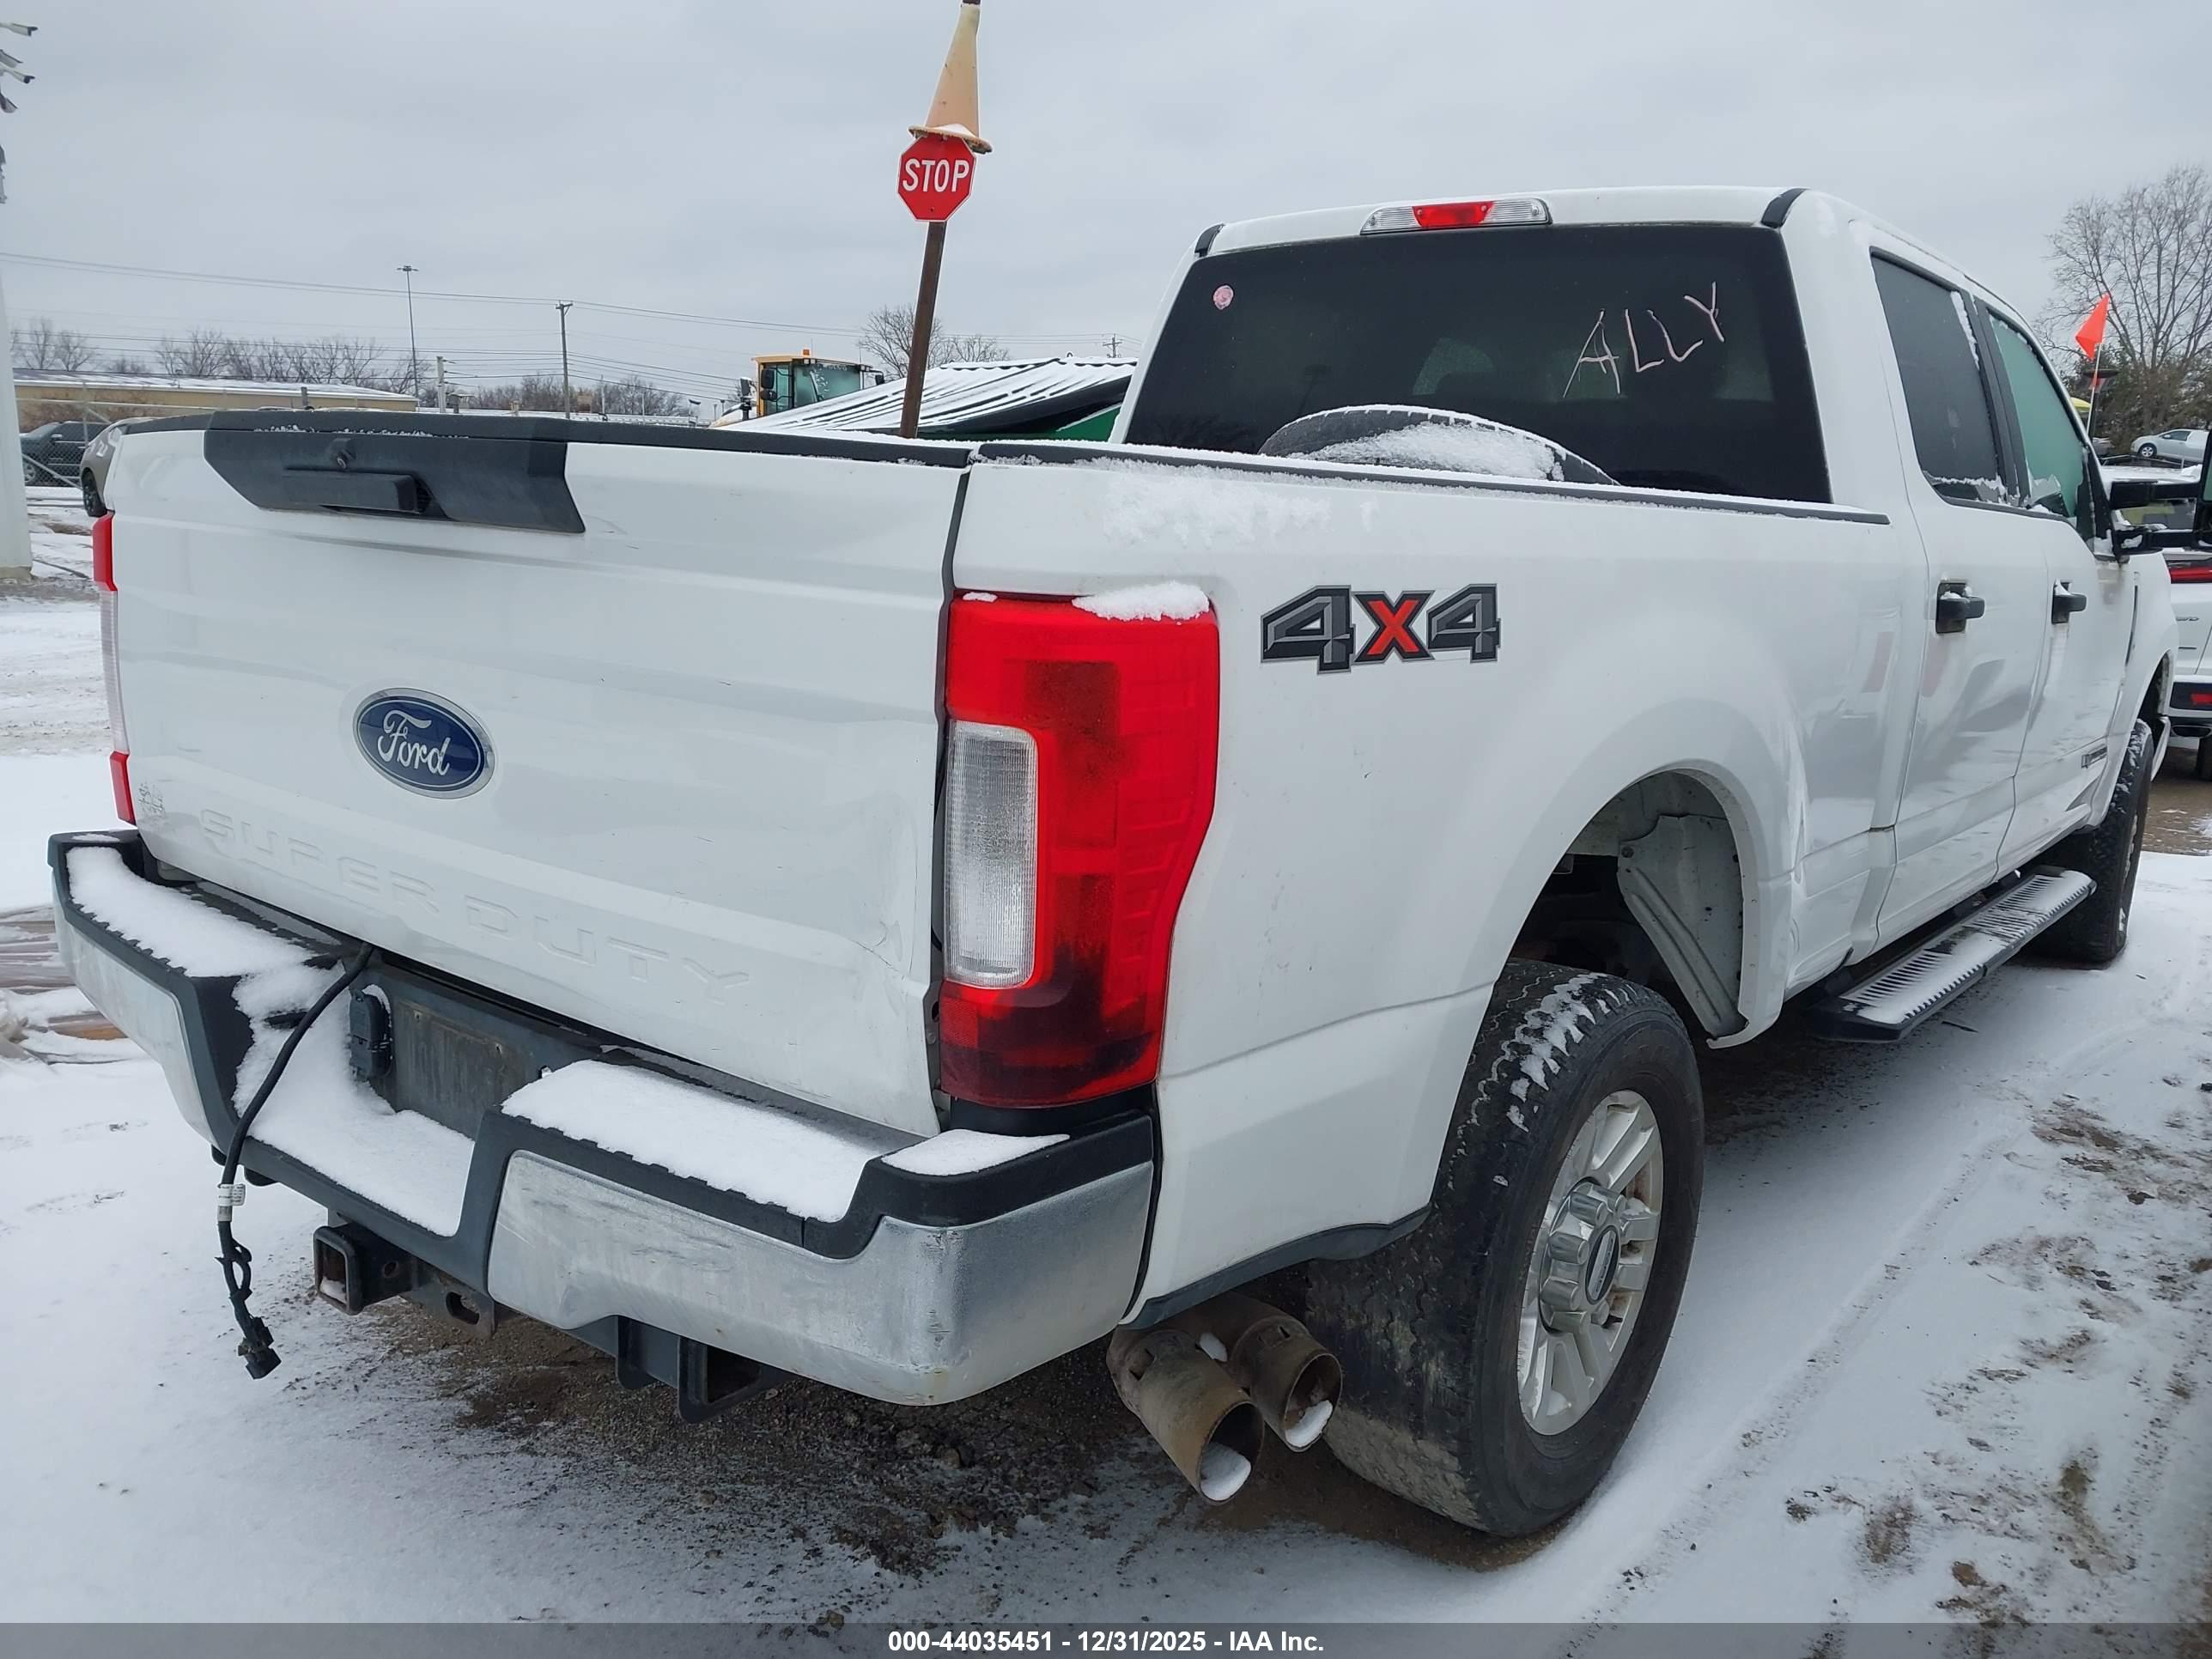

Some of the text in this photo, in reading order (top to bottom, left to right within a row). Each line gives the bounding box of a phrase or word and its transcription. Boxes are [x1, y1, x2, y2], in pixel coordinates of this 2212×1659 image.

[902, 158, 969, 192] STOP
[1563, 282, 1725, 398] ALLY
[377, 709, 452, 775] Ford
[198, 808, 750, 1006] SUPER DUTY
